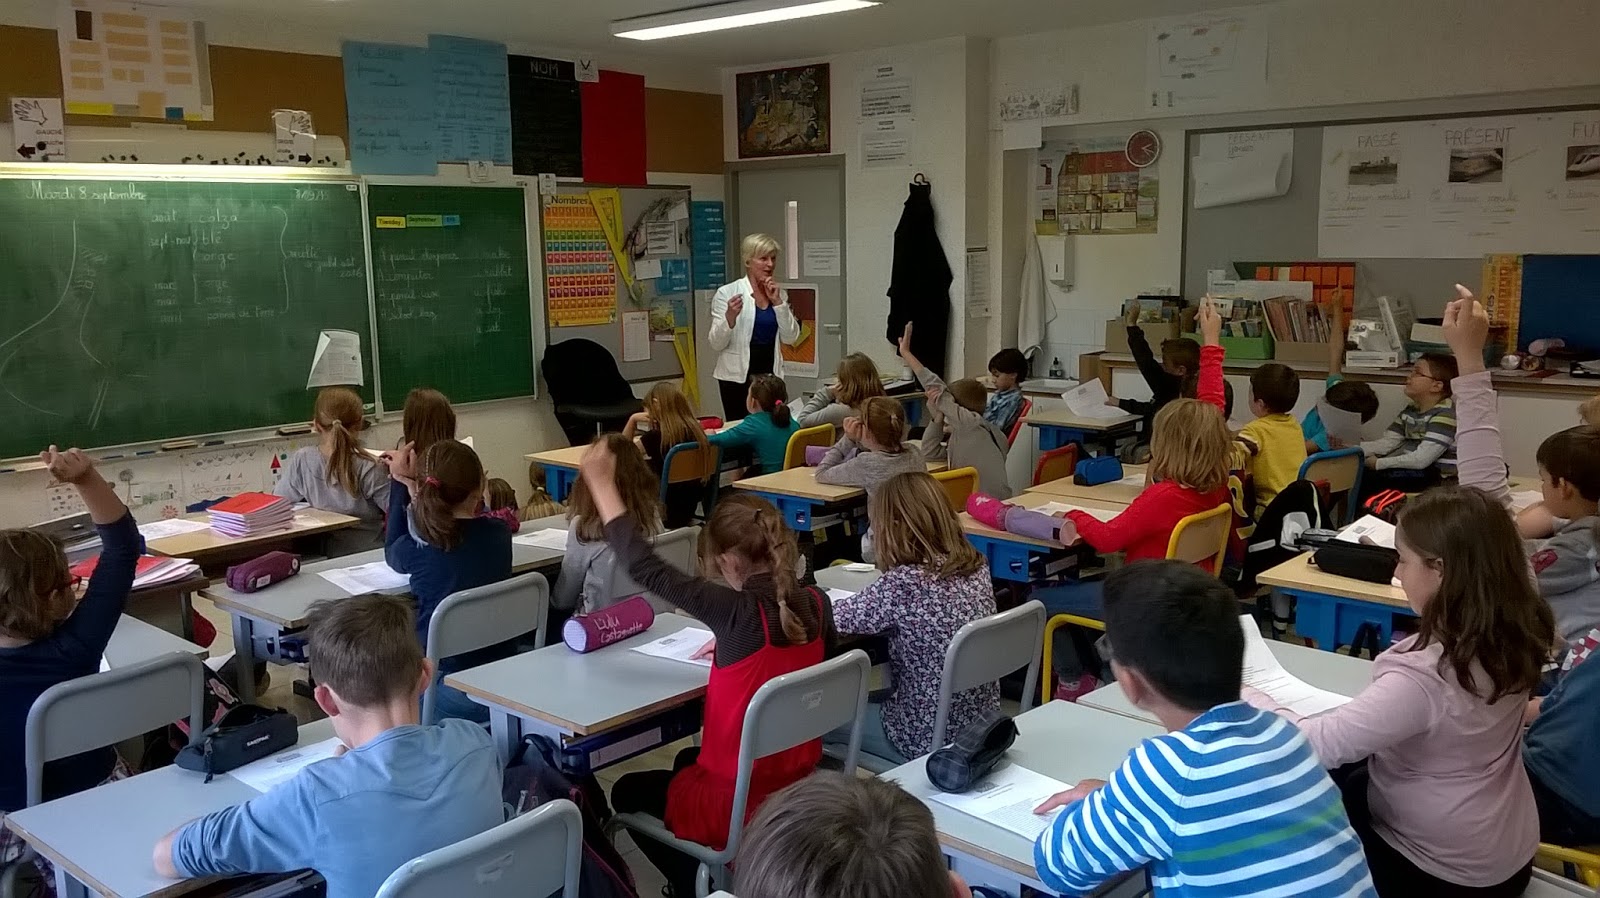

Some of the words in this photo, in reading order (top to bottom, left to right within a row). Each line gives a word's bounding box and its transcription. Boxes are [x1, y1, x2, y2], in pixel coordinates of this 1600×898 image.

[530, 60, 559, 78] NOM
[1445, 126, 1515, 146] PRÉSENT
[26, 180, 76, 200] Mardi
[79, 186, 87, 200] 8
[91, 182, 147, 204] septembre
[551, 195, 588, 205] Nombres
[200, 208, 238, 230] colza
[202, 229, 222, 246] blé
[203, 252, 237, 270] orge
